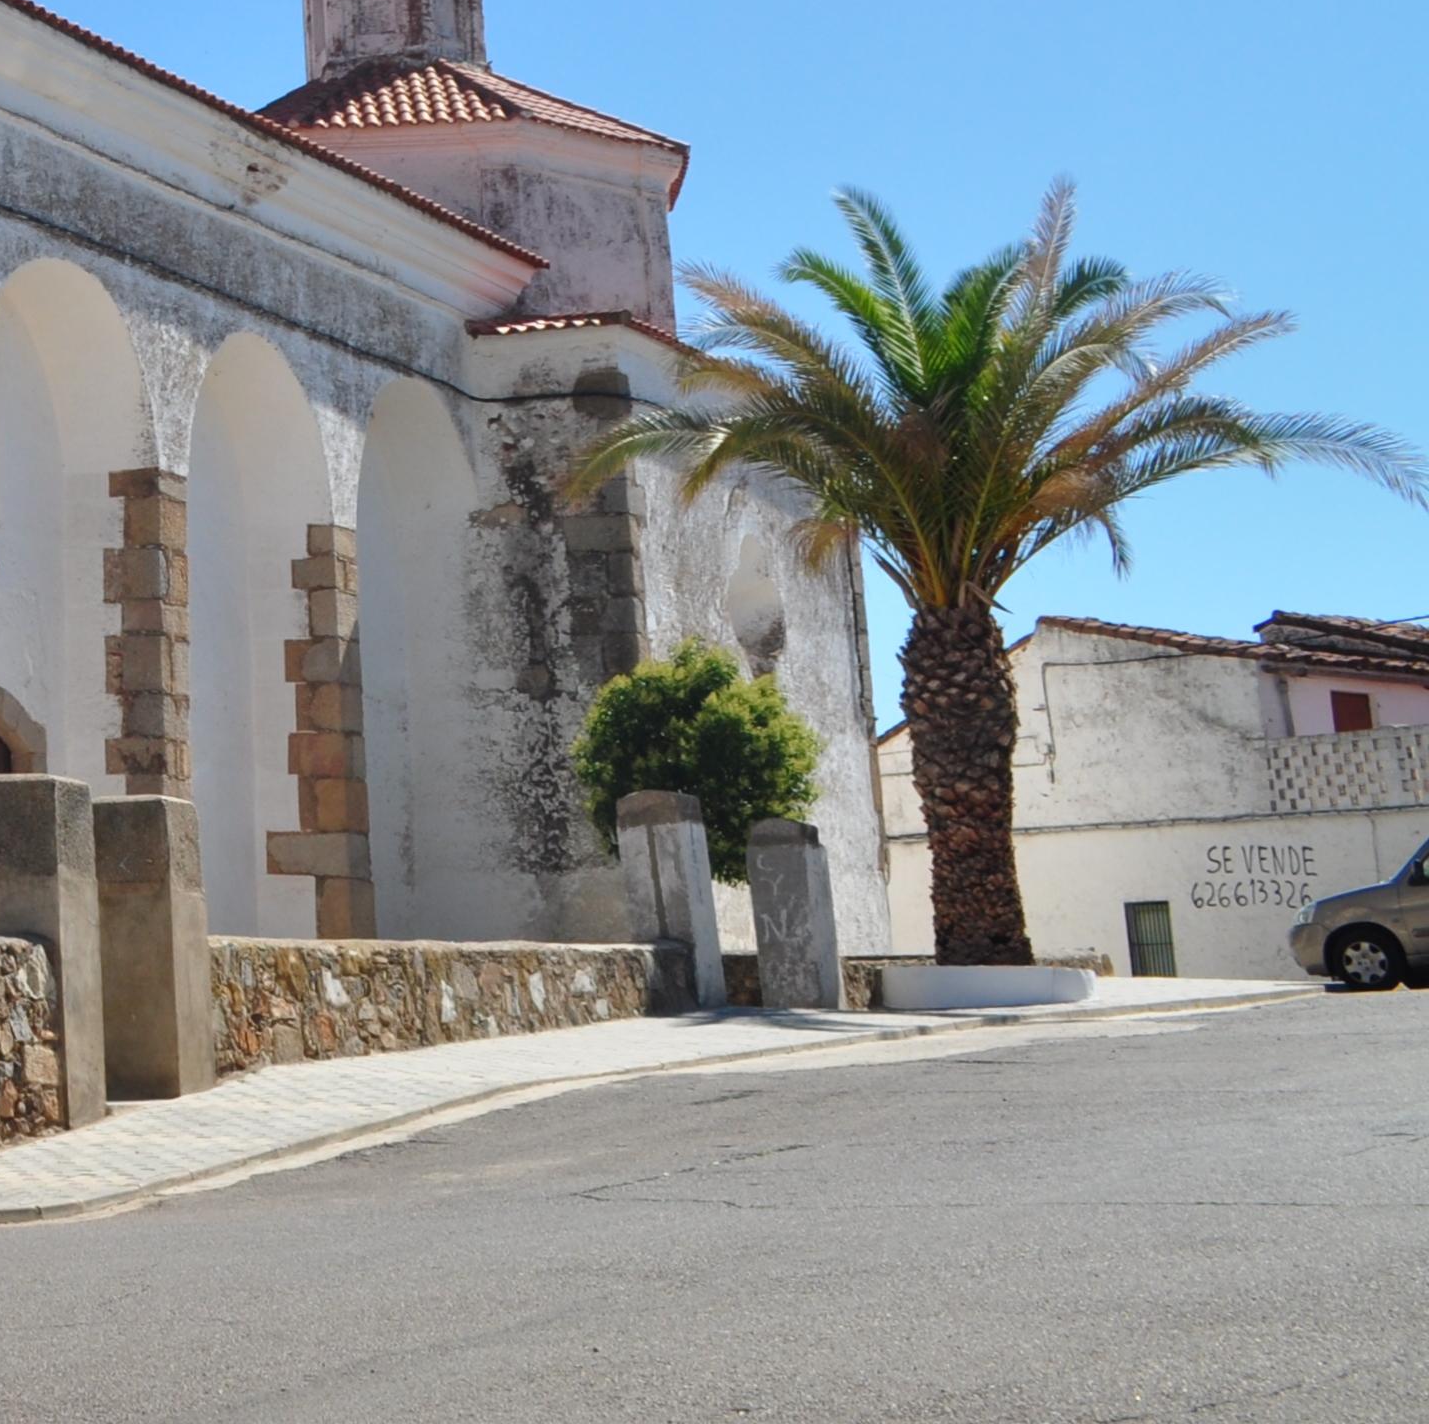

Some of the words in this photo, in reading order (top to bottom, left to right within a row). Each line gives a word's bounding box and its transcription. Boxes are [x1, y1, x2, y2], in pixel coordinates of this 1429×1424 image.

[1206, 844, 1234, 874] SE
[1240, 844, 1318, 876] VENDE
[1190, 878, 1312, 909] 626613326
